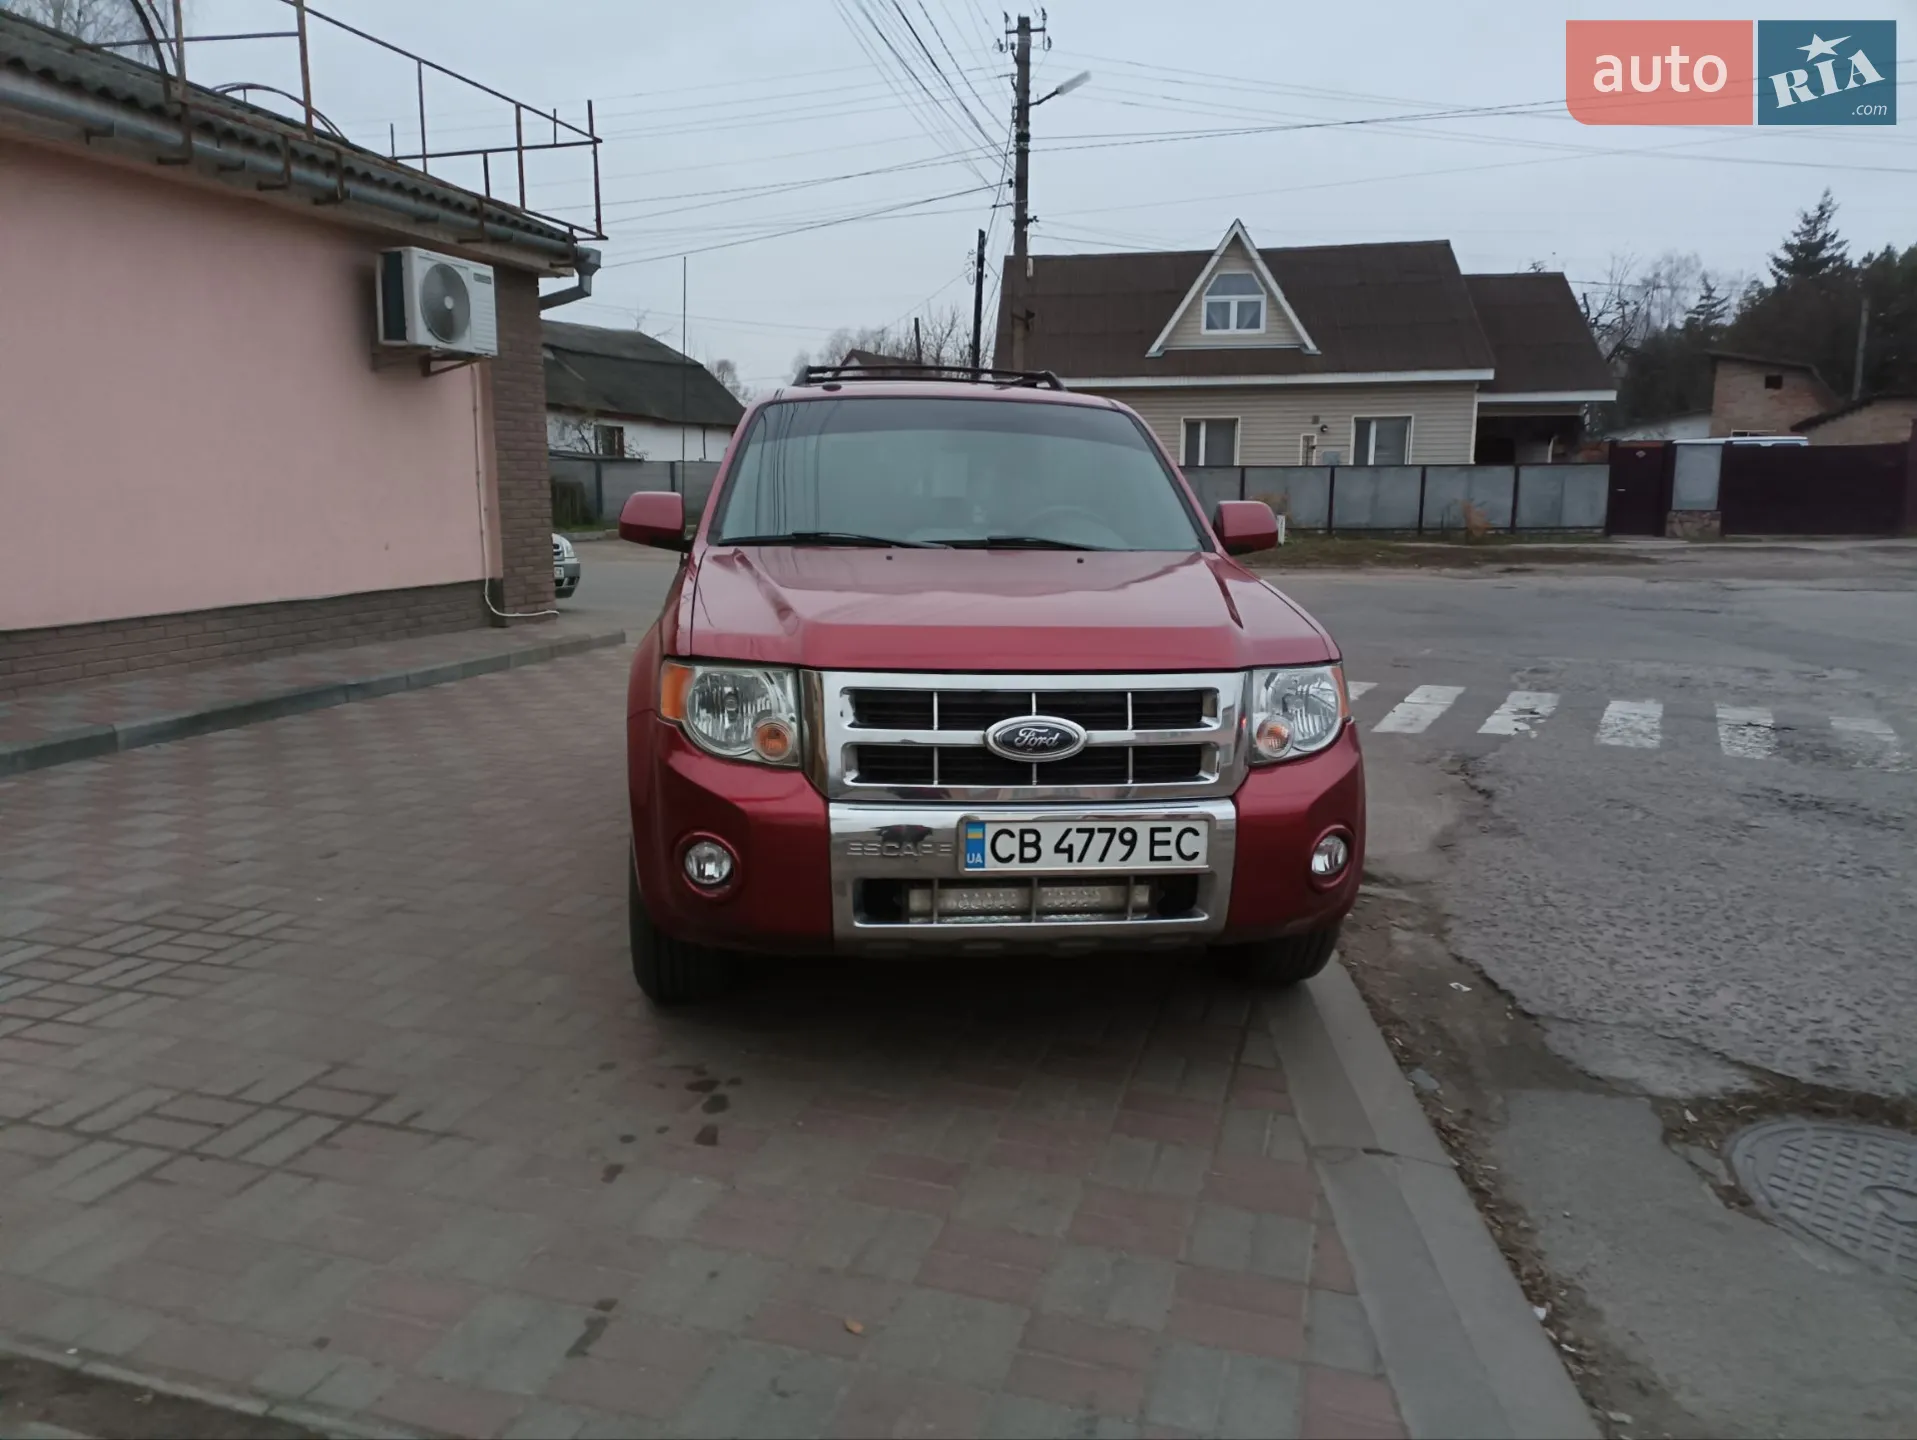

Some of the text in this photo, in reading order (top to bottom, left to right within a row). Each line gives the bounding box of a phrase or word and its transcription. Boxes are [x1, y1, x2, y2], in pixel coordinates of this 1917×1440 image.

[1014, 727, 1061, 747] Ford
[846, 842, 953, 857] ESCAPE
[990, 826, 1200, 864] CB 4779 EC
[966, 853, 983, 865] UA
